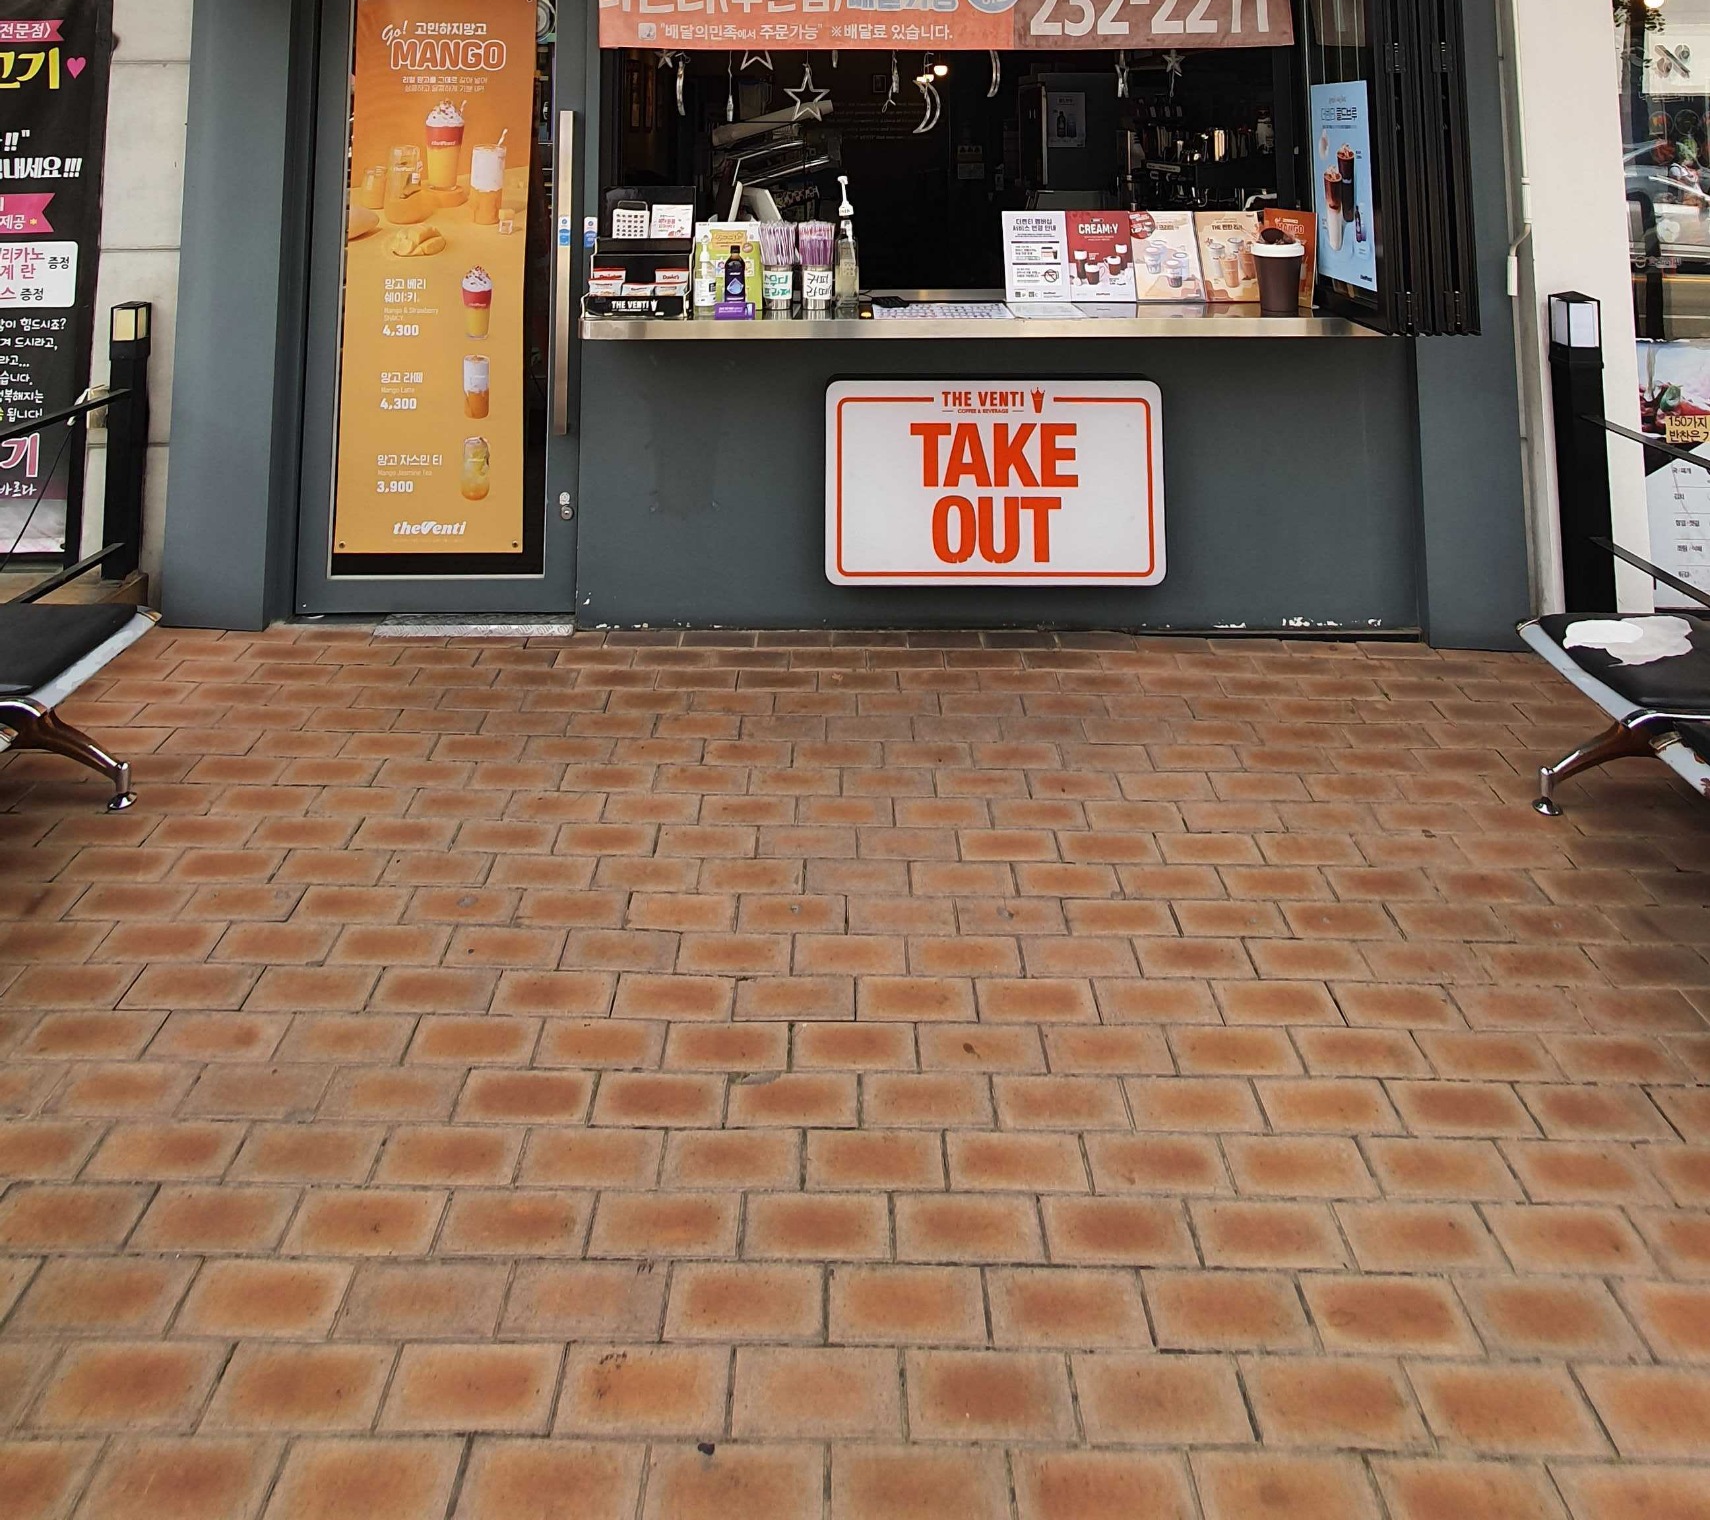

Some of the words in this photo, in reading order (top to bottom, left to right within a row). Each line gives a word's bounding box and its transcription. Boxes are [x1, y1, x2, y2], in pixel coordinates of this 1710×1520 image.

[381, 20, 408, 46] Go!
[414, 22, 487, 36] 고민하지망고
[891, 23, 954, 41] 있습니다.
[391, 39, 507, 71] MANGO
[0, 156, 83, 179] 내세요!!!
[0, 247, 45, 264] 리카노
[47, 256, 70, 270] 증정
[384, 278, 405, 290] 망고
[406, 278, 426, 290] 베리
[20, 287, 44, 301] 증정
[611, 300, 626, 309] THE
[20, 317, 68, 332] 힘드시죠?
[382, 324, 420, 337] 4,300
[14, 337, 58, 352] 드시라고,
[381, 372, 401, 384] 망고
[403, 371, 424, 383] 라떼
[380, 398, 417, 410] 4,300
[942, 391, 972, 407] THE
[977, 391, 1025, 407] VENTI
[1668, 415, 1708, 429] 150가지
[377, 454, 398, 466] 망고
[399, 454, 430, 466] 자스민
[432, 454, 443, 466] 티
[910, 422, 1079, 488] TAKE
[376, 480, 414, 493] 3,900
[393, 520, 467, 536] theVenti
[931, 495, 1062, 564] OUT
